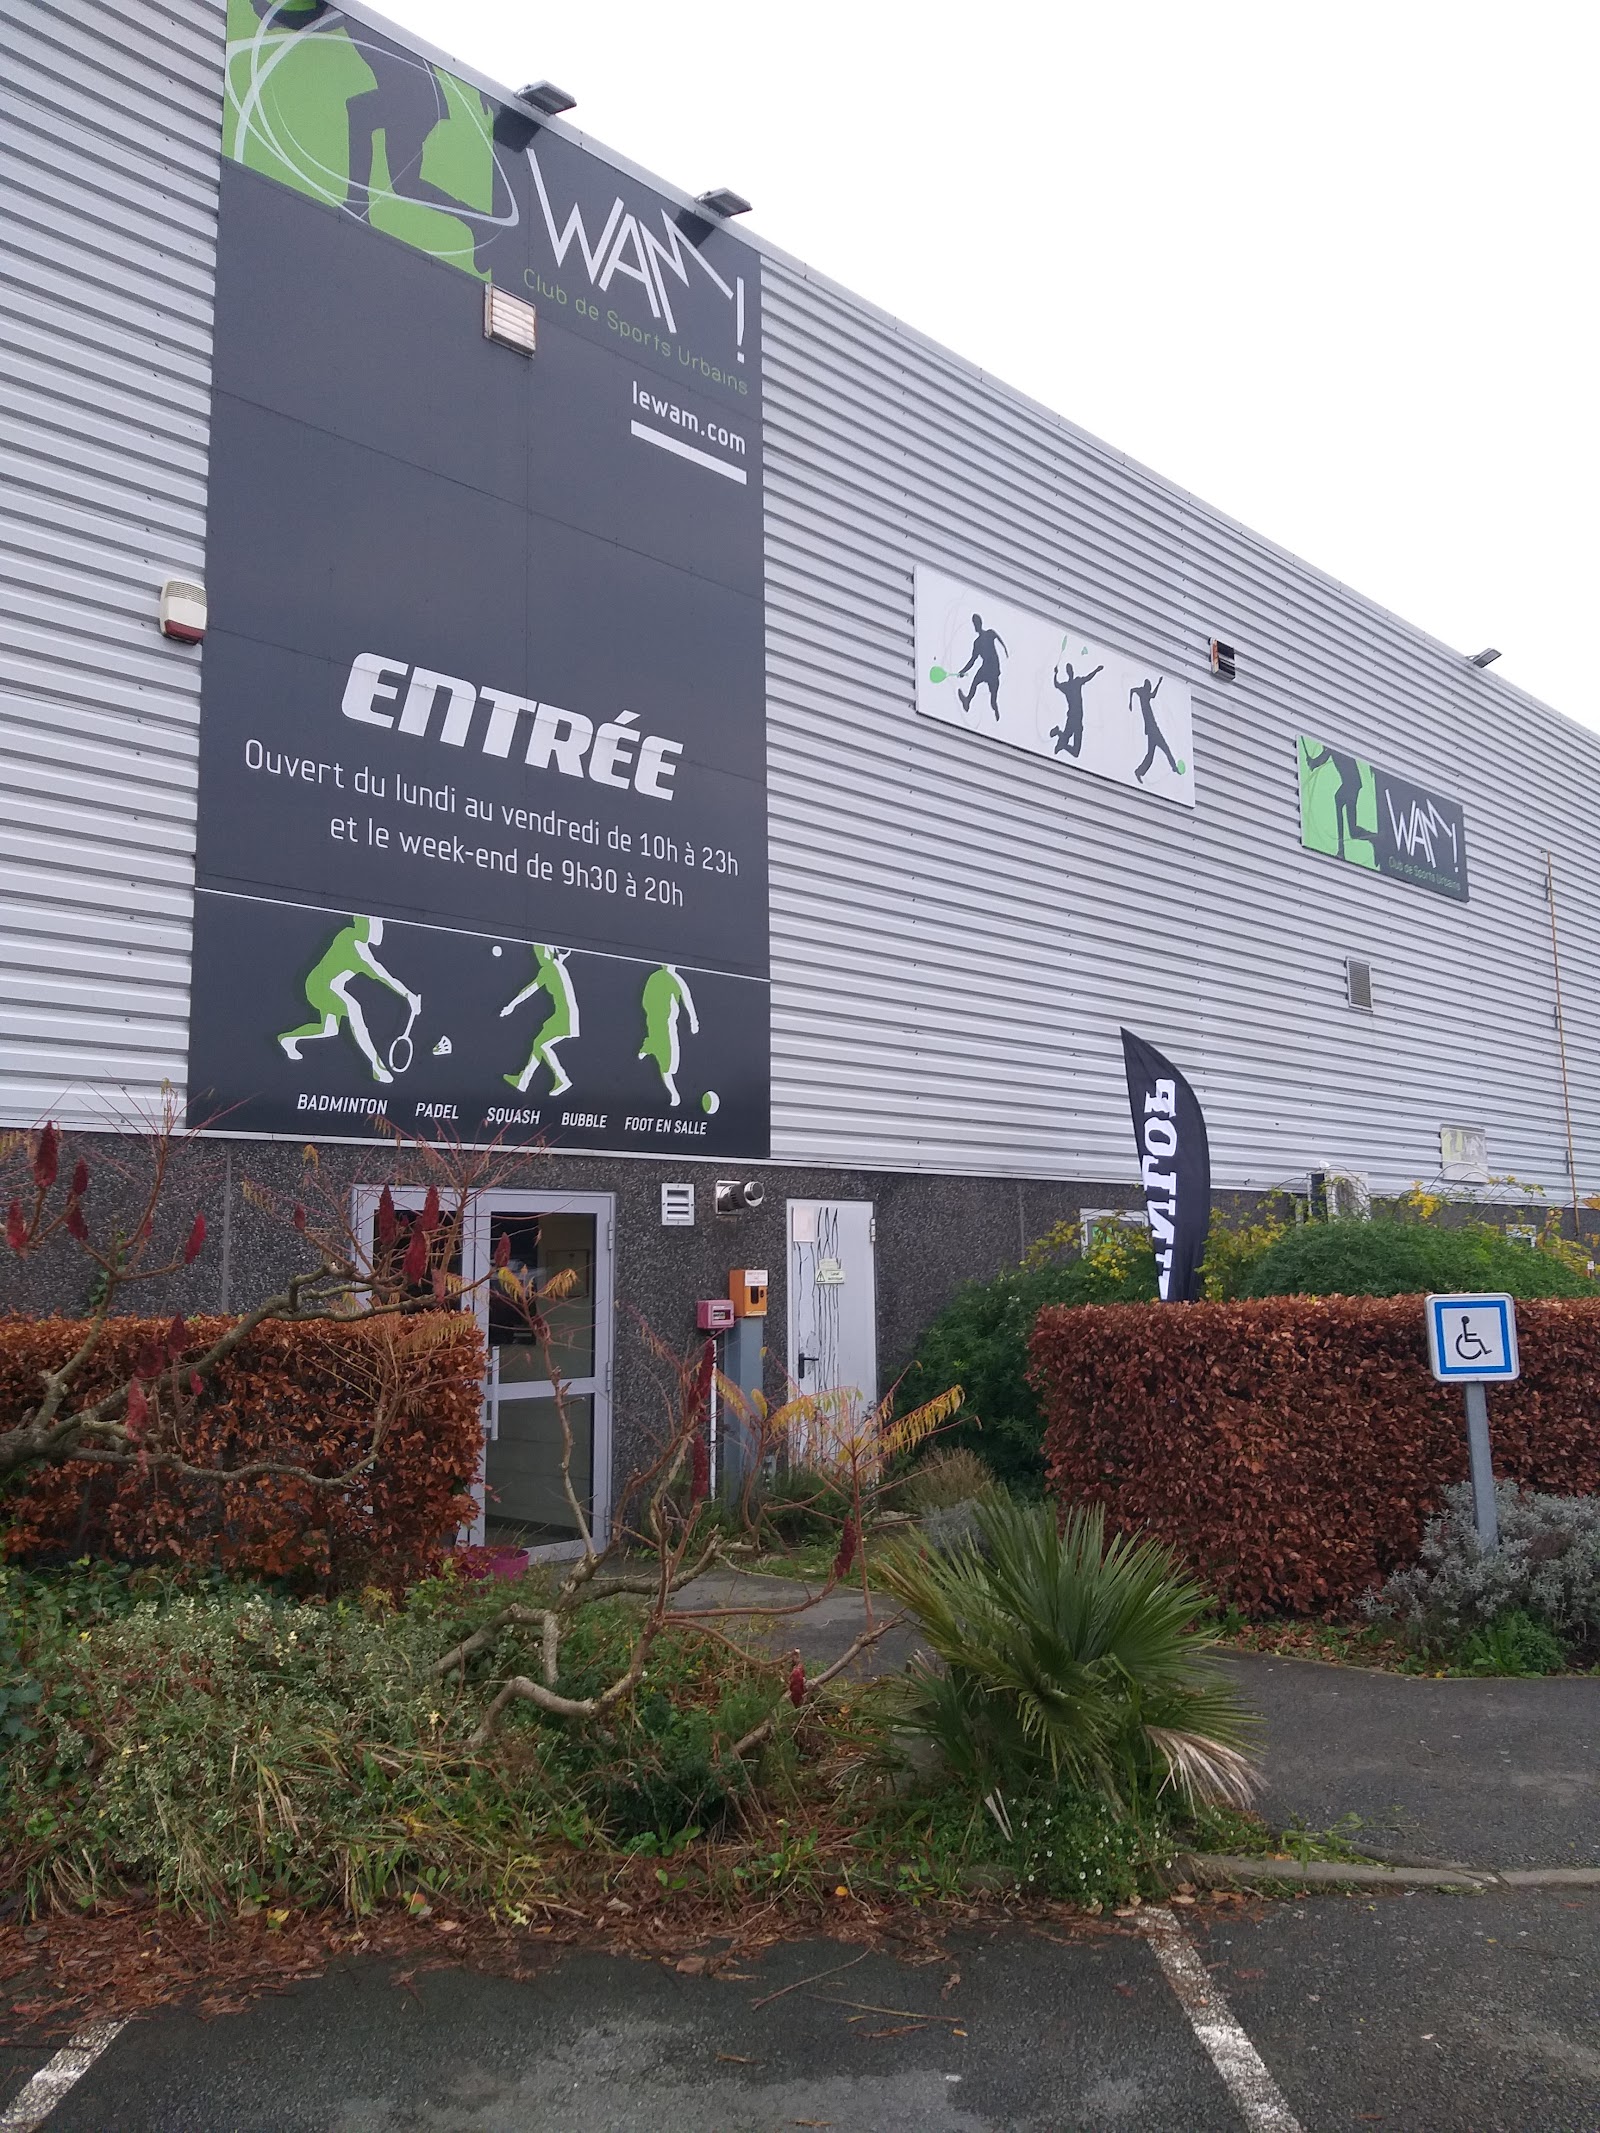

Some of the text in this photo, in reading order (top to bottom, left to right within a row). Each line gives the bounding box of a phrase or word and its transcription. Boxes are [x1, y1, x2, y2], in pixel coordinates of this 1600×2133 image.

[523, 268, 748, 395] Club de Sports Urbains
[633, 380, 745, 455] lewam.com
[341, 652, 684, 801] ENTRÉE
[245, 739, 739, 877] Ouvert du lundi au vendredi de 10h à 23h
[330, 815, 683, 907] et le week-end de 9h30 à 20h
[297, 1093, 388, 1116] BADMINTON
[415, 1102, 459, 1120] PADEL
[486, 1106, 541, 1125] SQUASH
[561, 1111, 608, 1128] BUBBLE
[625, 1116, 707, 1135] FOOT EN SALLE
